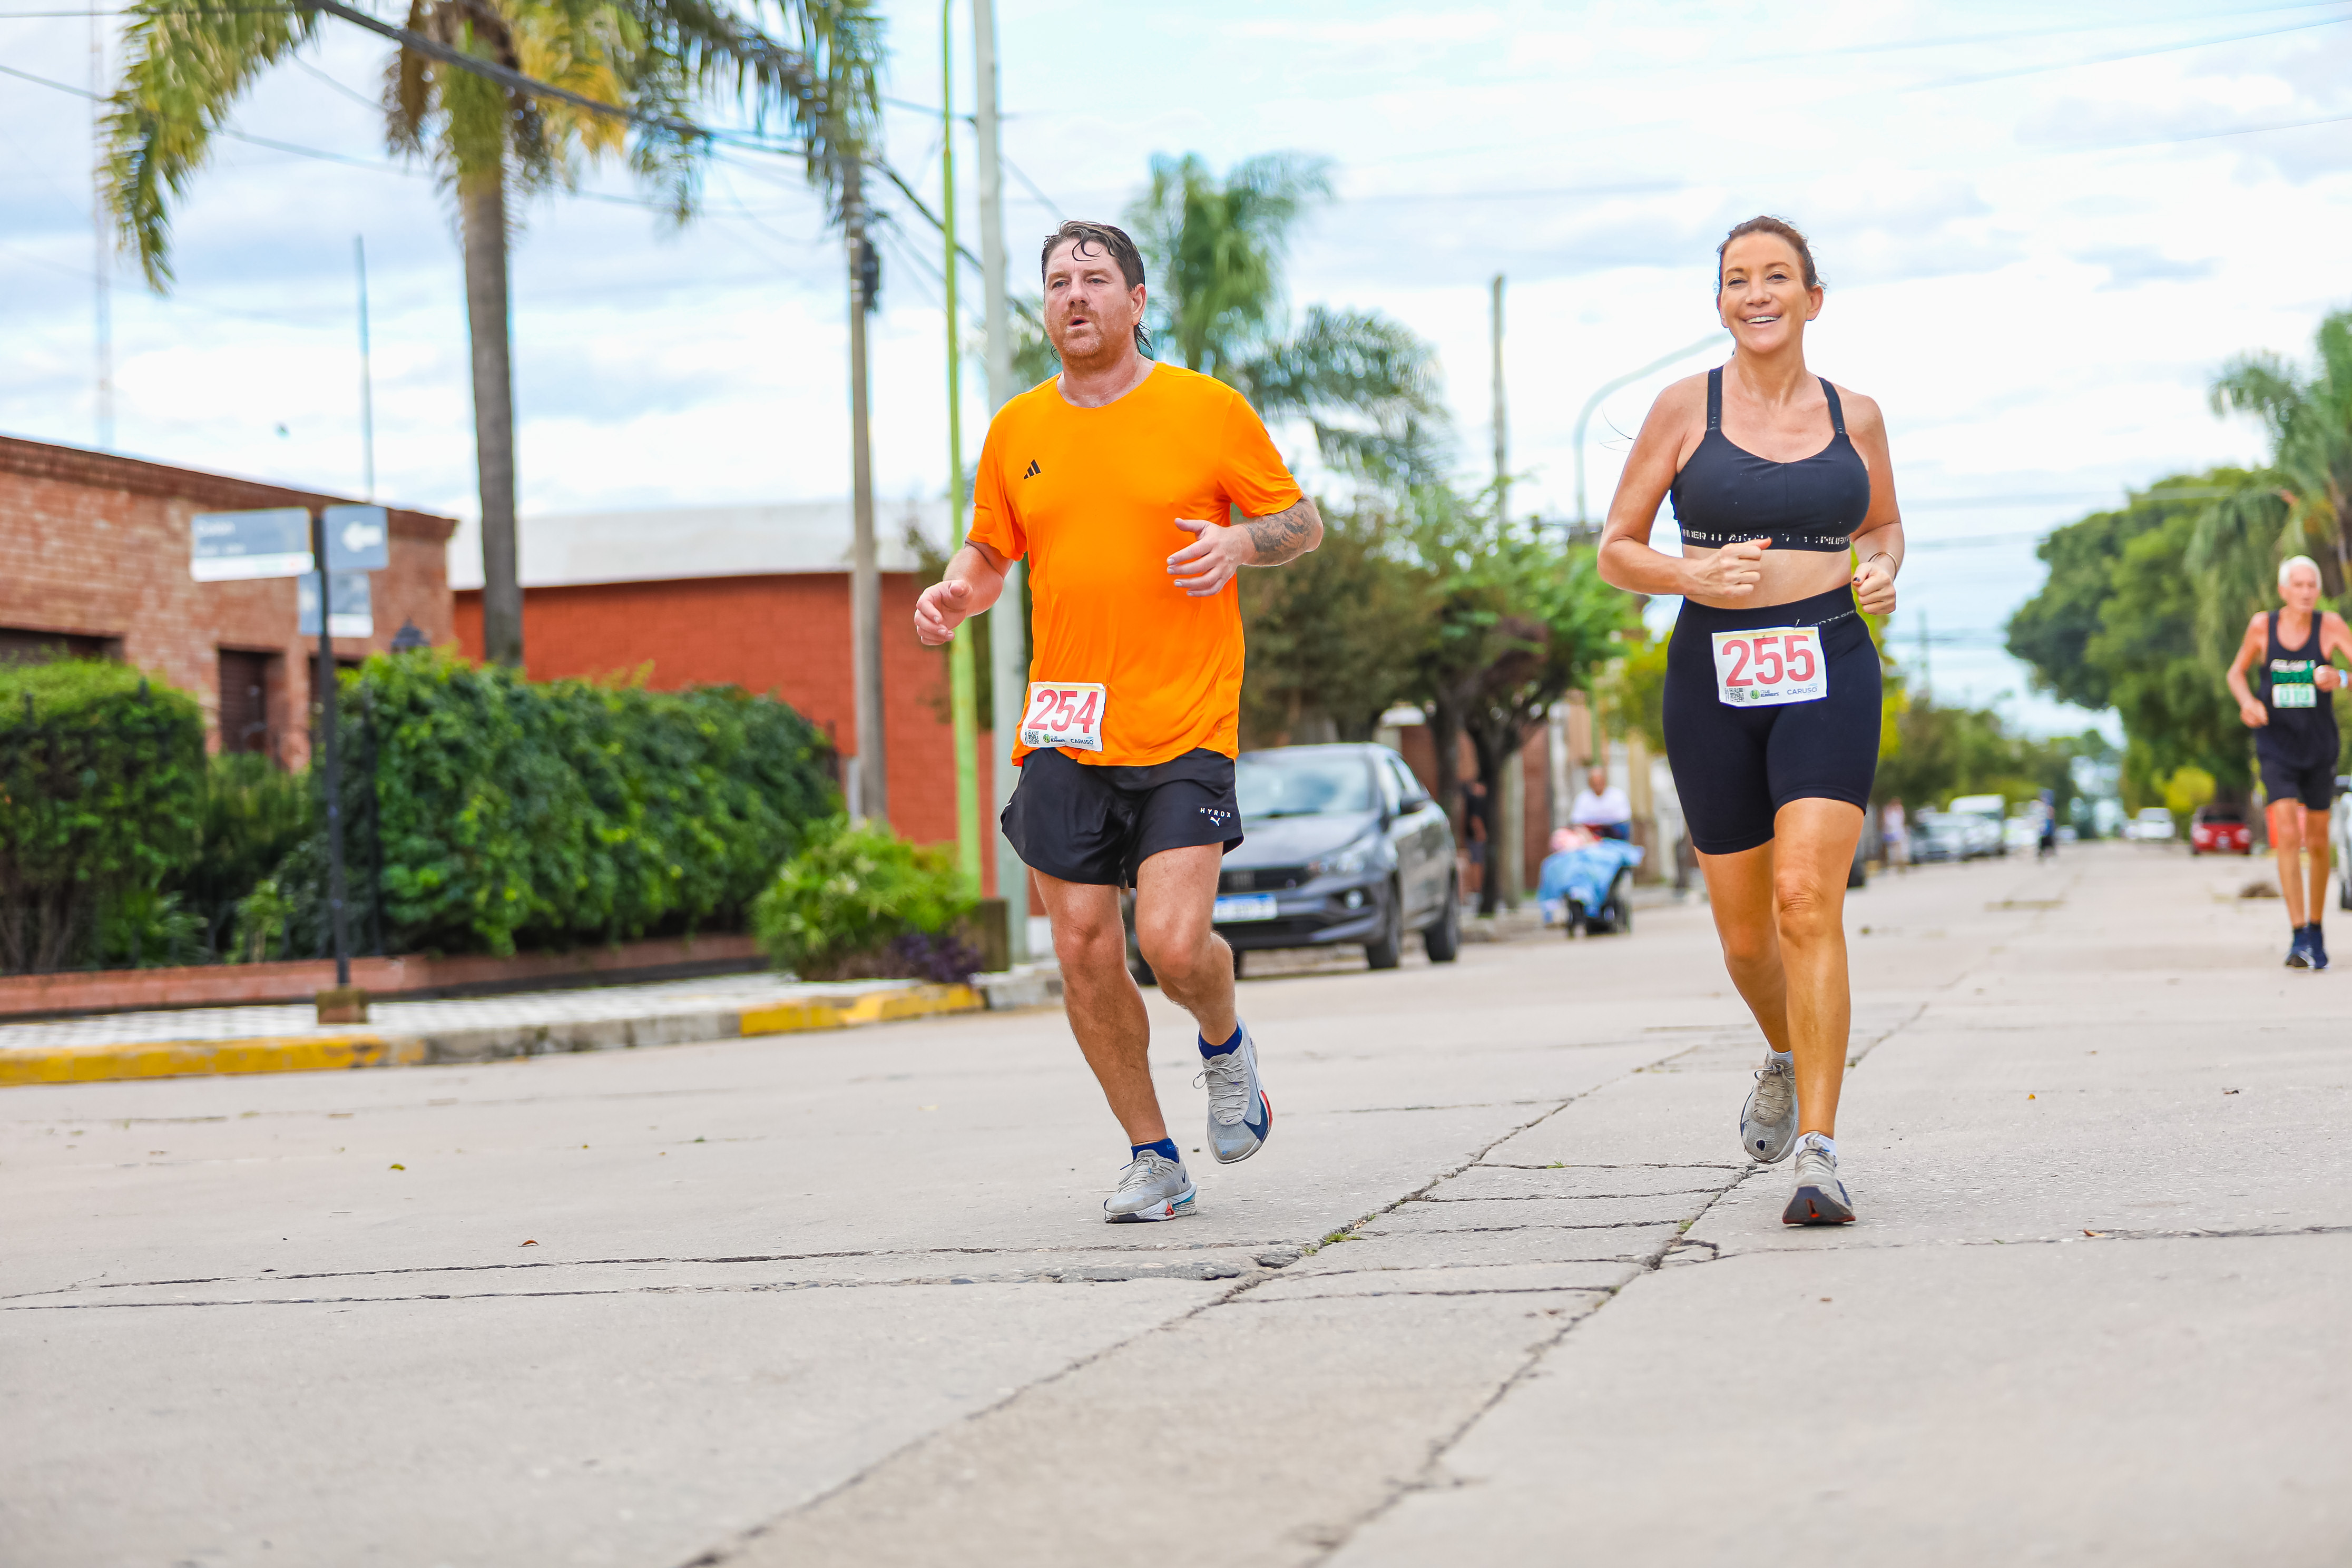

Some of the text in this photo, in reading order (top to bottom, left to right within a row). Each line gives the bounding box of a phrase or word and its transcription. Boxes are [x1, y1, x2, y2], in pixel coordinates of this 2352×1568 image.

[1722, 635, 1816, 687] 255
[1027, 689, 1098, 733] 254
[1200, 807, 1231, 818] HYROX
